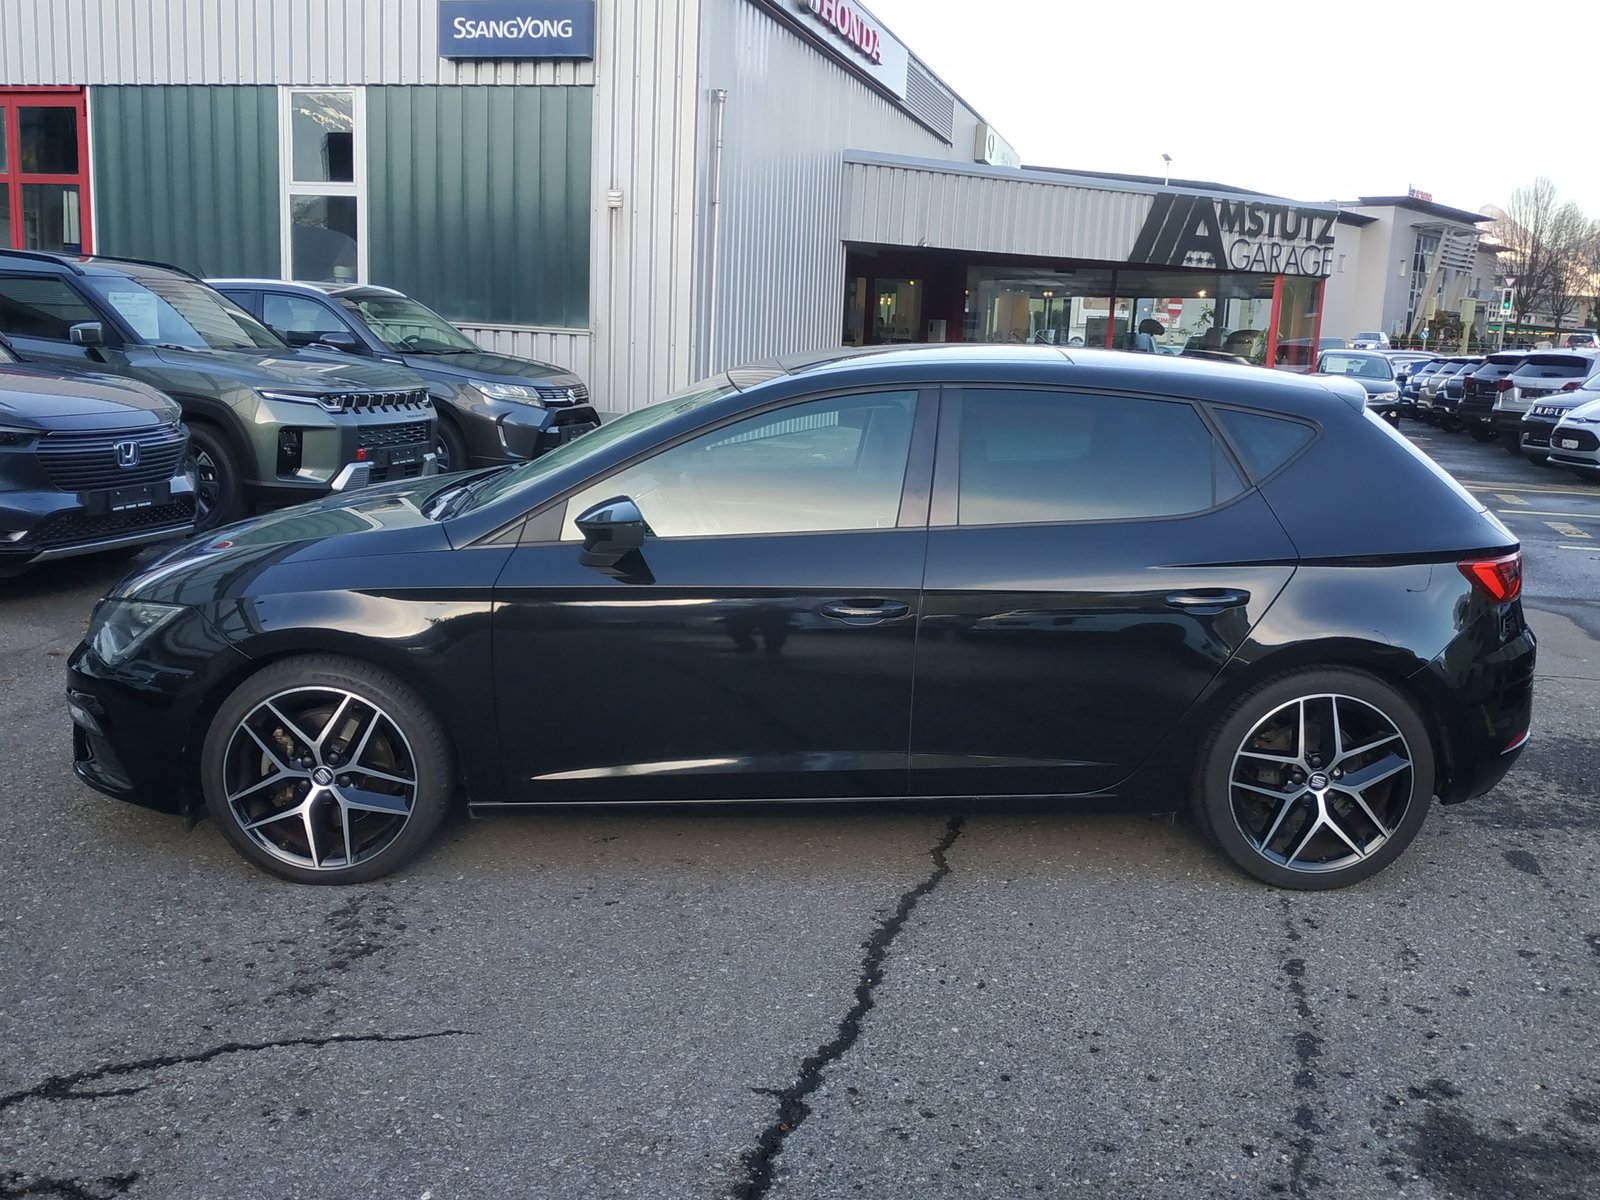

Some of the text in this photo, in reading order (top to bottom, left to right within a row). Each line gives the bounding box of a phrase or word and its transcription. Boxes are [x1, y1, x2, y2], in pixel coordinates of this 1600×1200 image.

[453, 16, 572, 39] SSANGYONG
[820, 0, 882, 63] HONDA
[1168, 195, 1339, 269] AMSTUTZ
[1229, 238, 1334, 276] GARAGE
